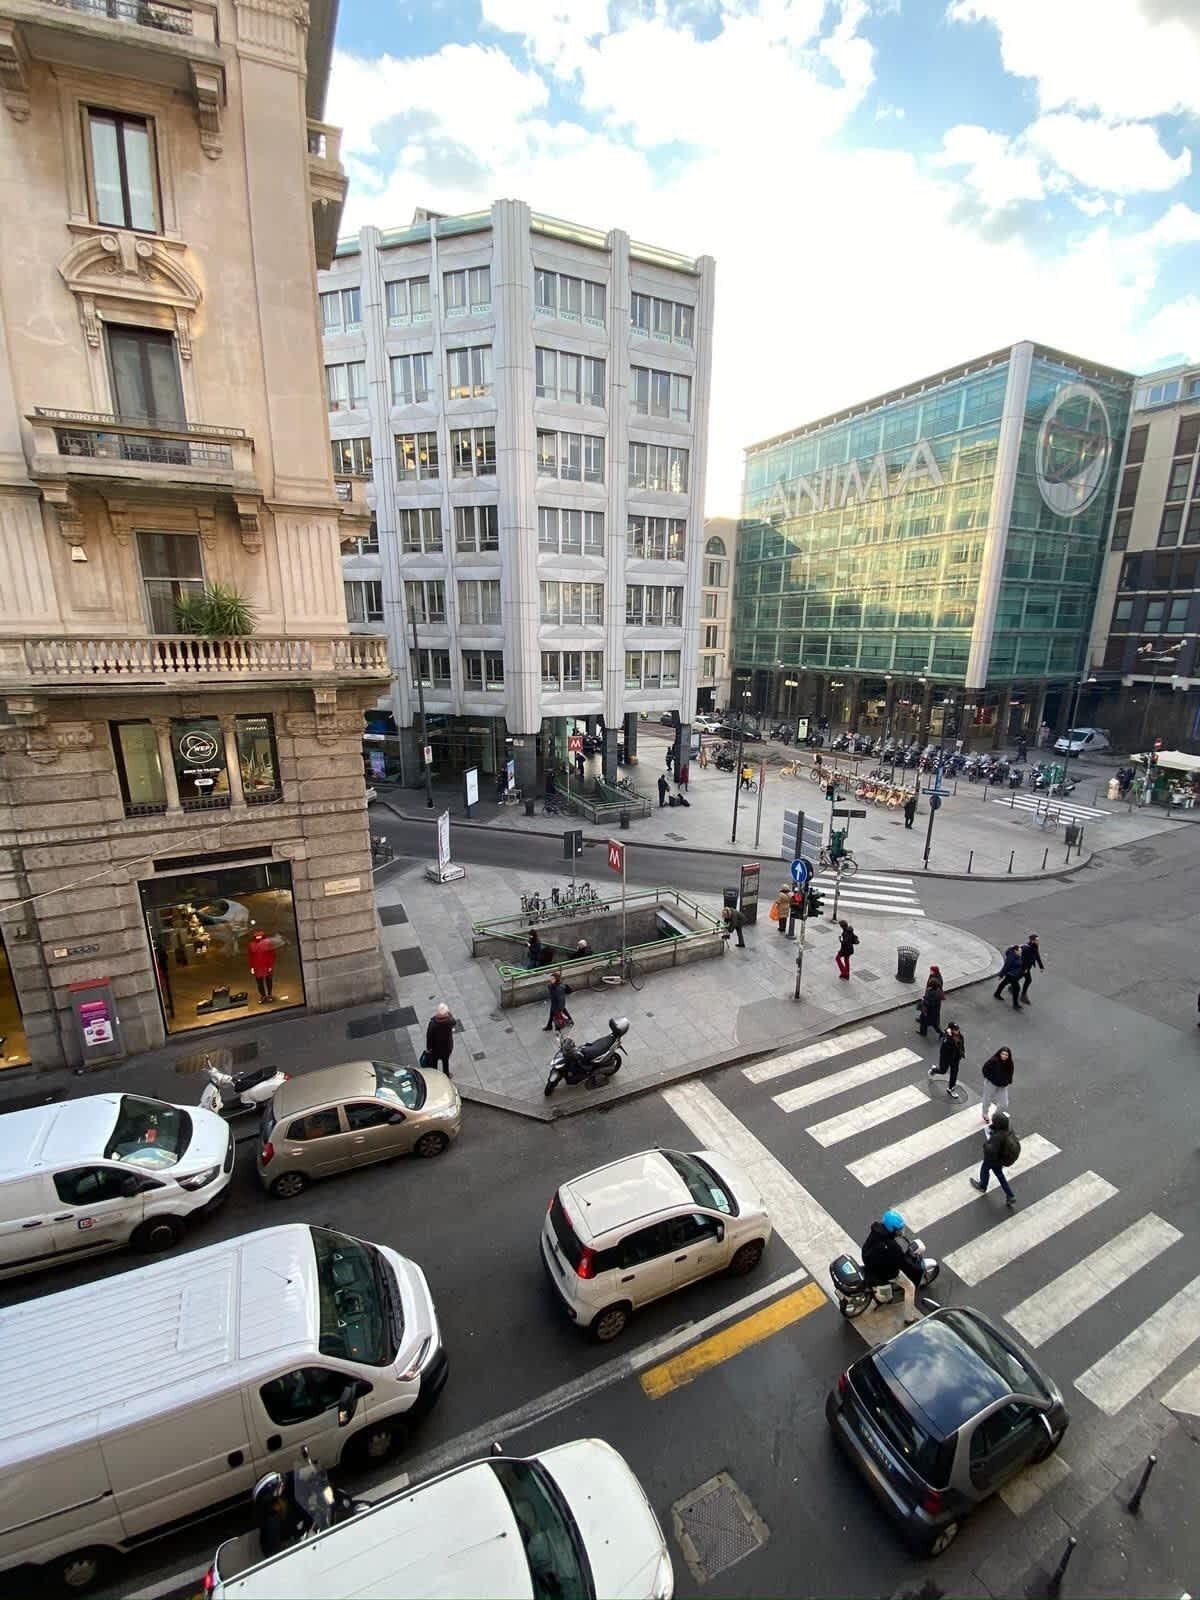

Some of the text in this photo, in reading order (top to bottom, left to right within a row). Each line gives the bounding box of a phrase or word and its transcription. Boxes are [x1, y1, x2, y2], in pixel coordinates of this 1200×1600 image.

[766, 439, 944, 519] ANIMA
[570, 739, 581, 748] M
[609, 847, 621, 869] M
